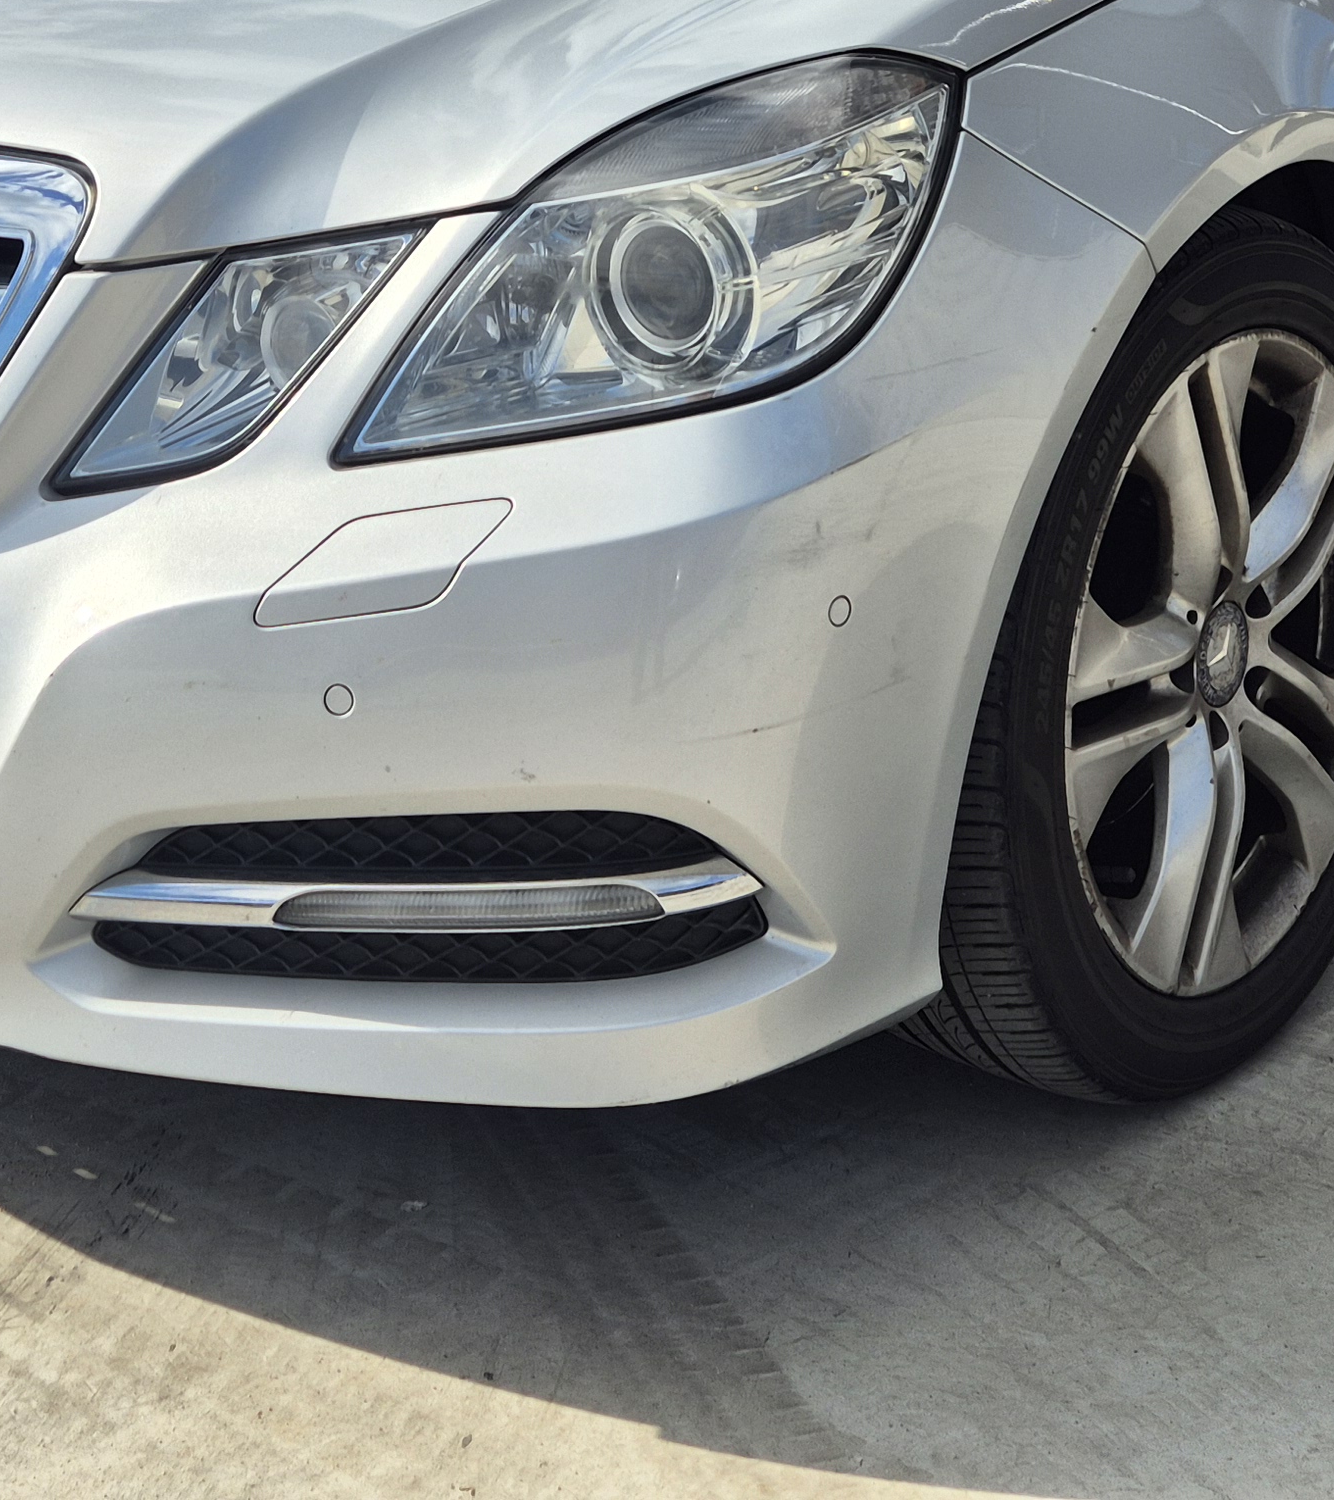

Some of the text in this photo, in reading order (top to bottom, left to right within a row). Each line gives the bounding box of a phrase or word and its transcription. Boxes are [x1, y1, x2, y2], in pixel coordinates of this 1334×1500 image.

[1034, 600, 1064, 736] 245/45
[1055, 486, 1089, 591] ZR17
[1086, 401, 1126, 485] 99W
